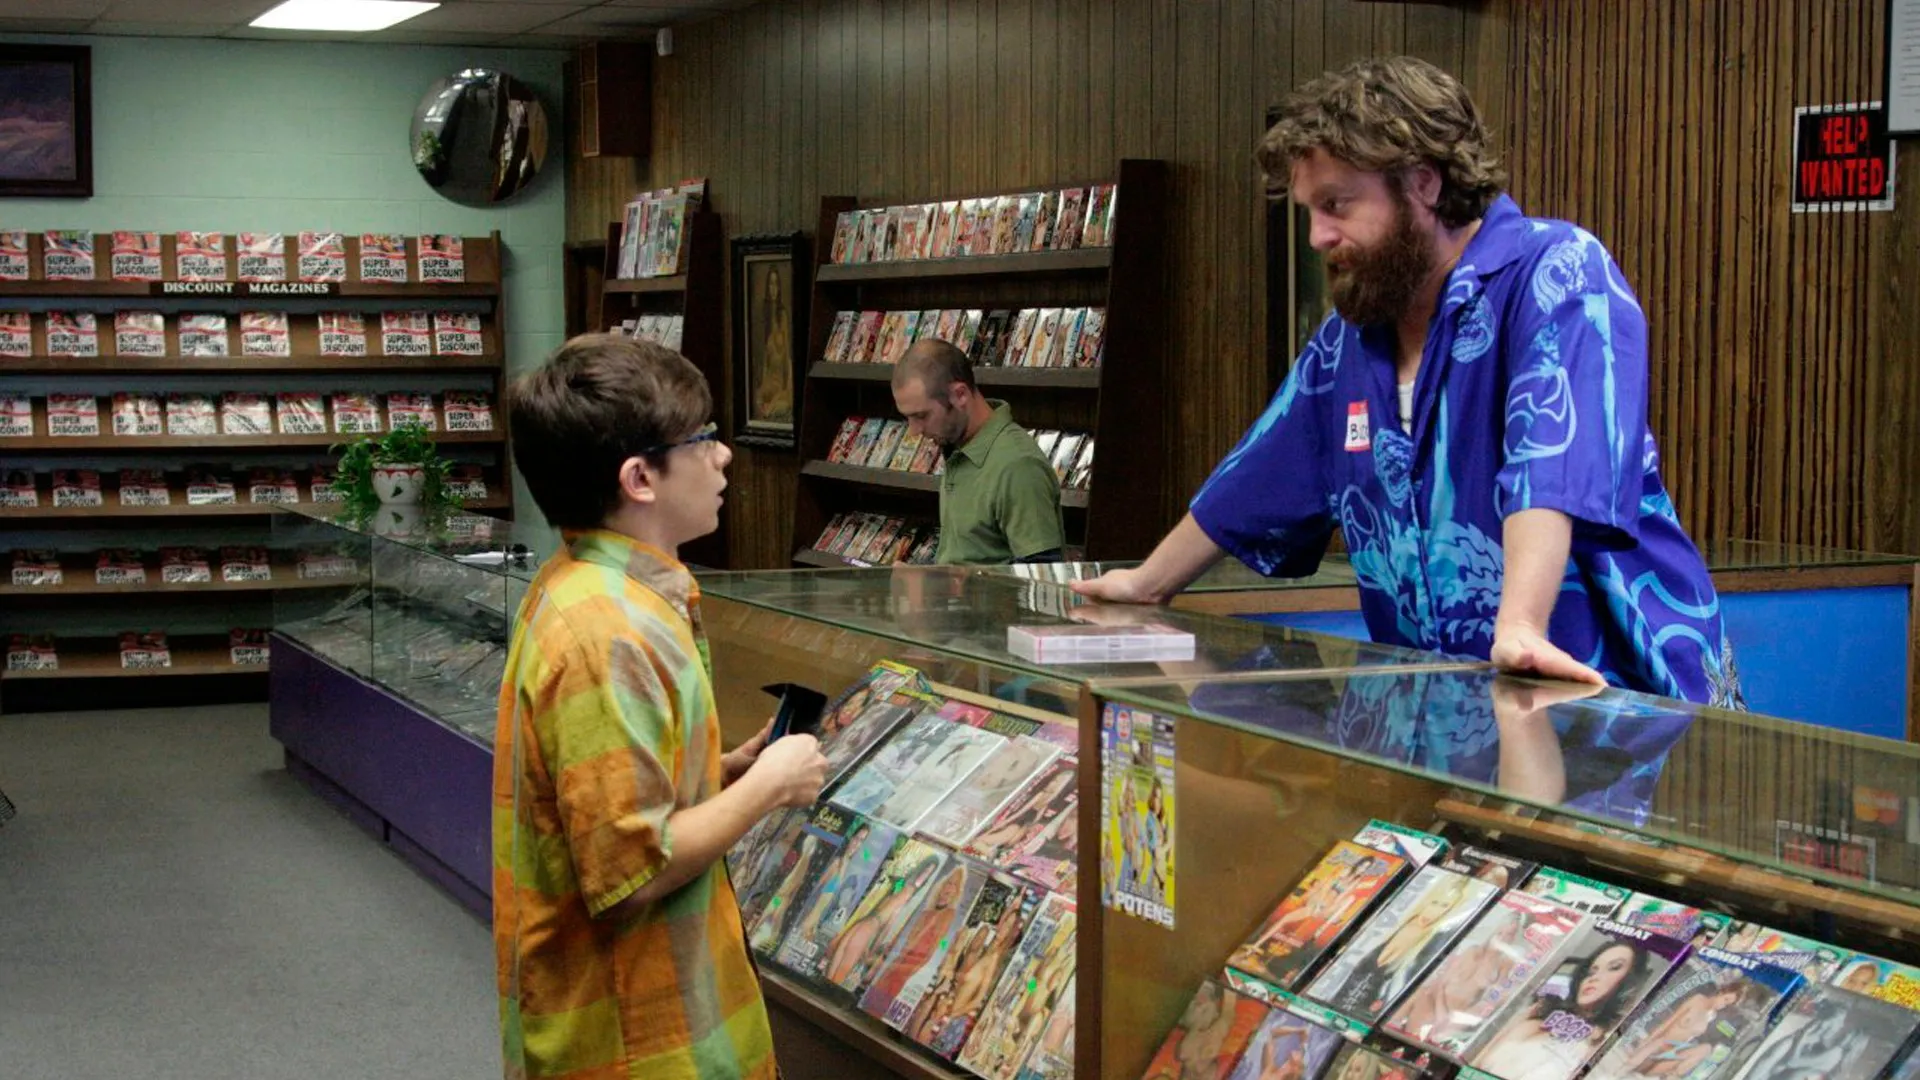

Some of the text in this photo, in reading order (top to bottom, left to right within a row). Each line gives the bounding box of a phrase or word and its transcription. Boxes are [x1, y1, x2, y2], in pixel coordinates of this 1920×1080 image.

[1801, 158, 1884, 197] WANTED
[47, 256, 75, 265] SUPER
[115, 256, 144, 265] SUPER
[241, 257, 267, 266] SUPER
[363, 259, 390, 268] SUPER
[422, 259, 449, 268] SUPER
[47, 266, 91, 275] DISCOUNT
[115, 266, 160, 275] DISCOUNT
[241, 267, 283, 276] DISCOUNT
[363, 268, 405, 277] DISCOUNT
[422, 268, 464, 277] DISCOUNT
[164, 282, 330, 293] DISCOUNT MAGAZINES
[183, 335, 210, 344] SUPER
[323, 335, 349, 343] SUPER
[387, 335, 412, 343] SUPER
[439, 334, 465, 342] SUPER
[51, 344, 94, 353] DISCOUNT
[323, 344, 365, 353] DISCOUNT
[386, 344, 427, 353] DISCOUNT
[439, 343, 480, 351] DISCOUNT
[51, 416, 80, 424] SUPER
[449, 412, 474, 421] SUPER
[52, 425, 96, 434] DISCOUNT
[1115, 891, 1175, 928] POTENS
[1596, 920, 1653, 940] COMBAT
[1699, 946, 1759, 969] COMBAT
